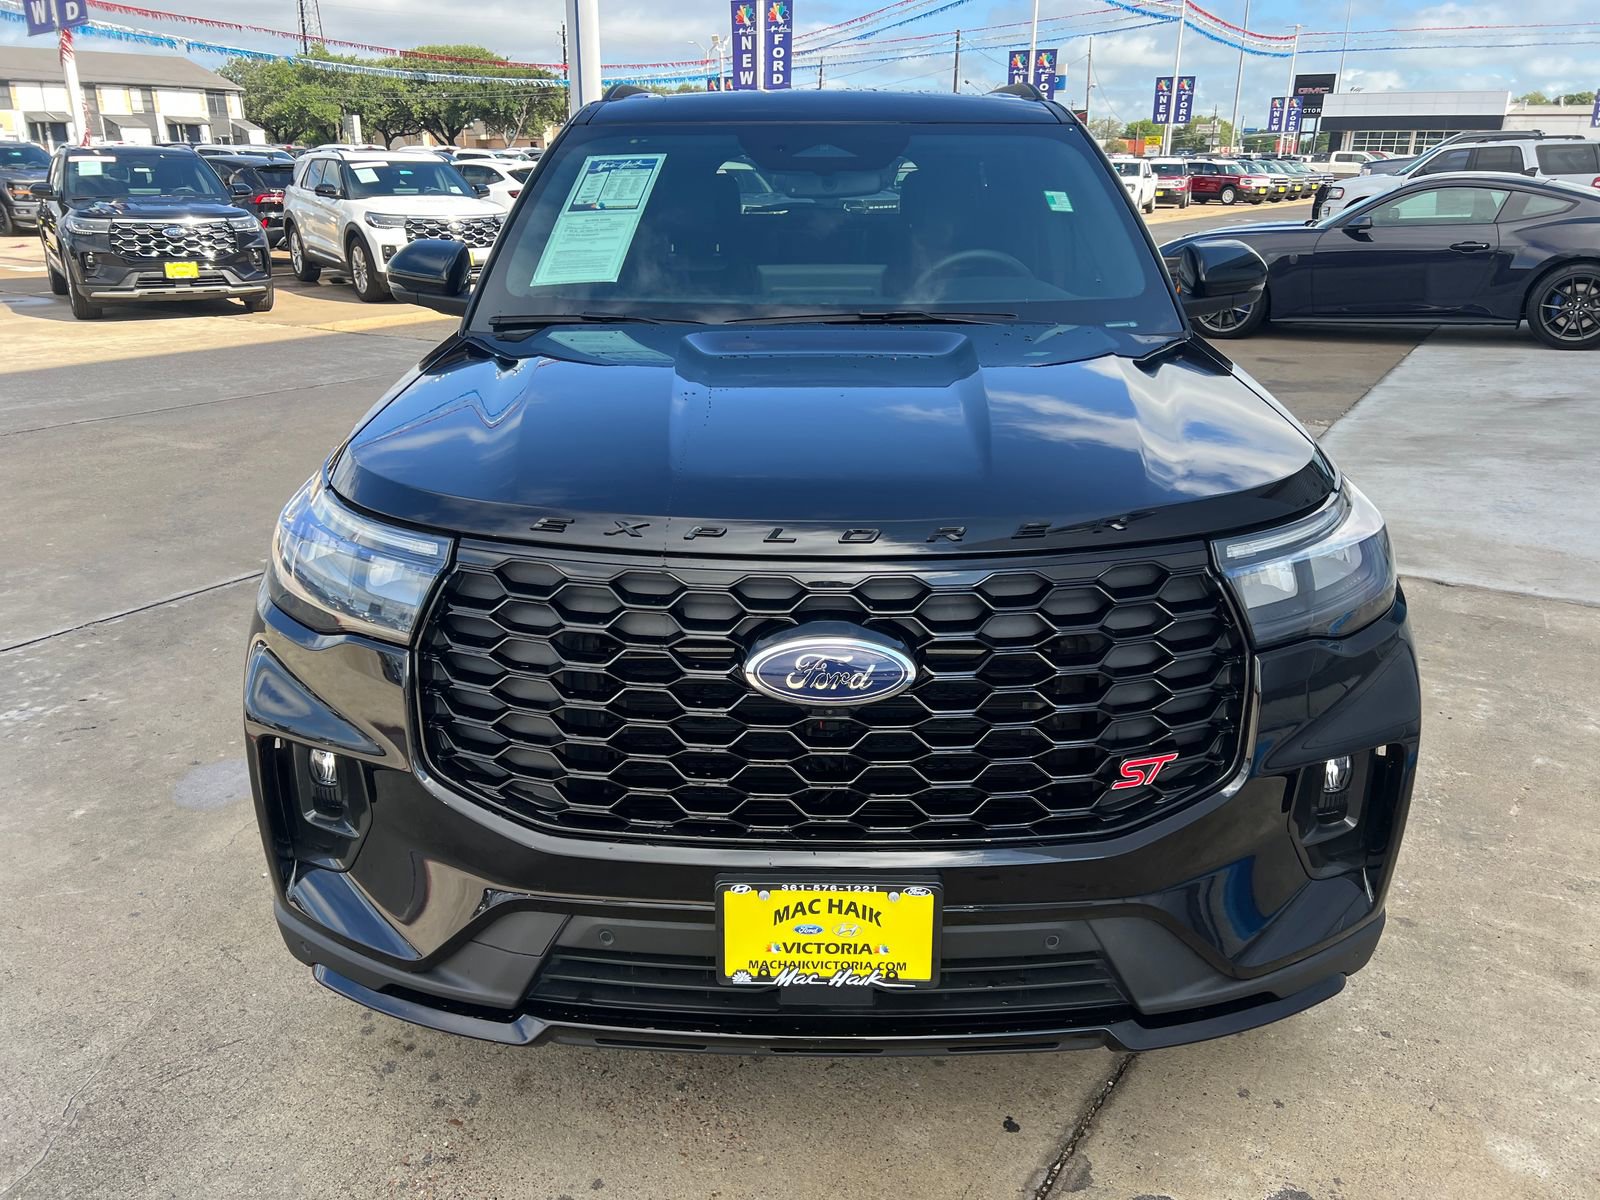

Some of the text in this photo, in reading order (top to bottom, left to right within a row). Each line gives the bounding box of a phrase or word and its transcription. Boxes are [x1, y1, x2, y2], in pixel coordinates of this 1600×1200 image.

[739, 36, 754, 85] NEW
[772, 34, 785, 85] FORD
[1157, 96, 1168, 121] NEW
[1178, 95, 1188, 121] FORD
[1288, 110, 1296, 131] FORD
[1271, 111, 1280, 131] NEW
[529, 511, 1128, 544] EXPLORER
[786, 654, 876, 690] Ford
[1111, 753, 1179, 790] ST
[781, 885, 877, 893] 361-576-1221
[773, 899, 882, 927] MAC HAIK
[796, 925, 821, 934] Ford
[782, 942, 873, 955] VICTORIA
[748, 960, 907, 971] MACHAIKVICTORIA.COM
[774, 967, 884, 988] Mac Haik
